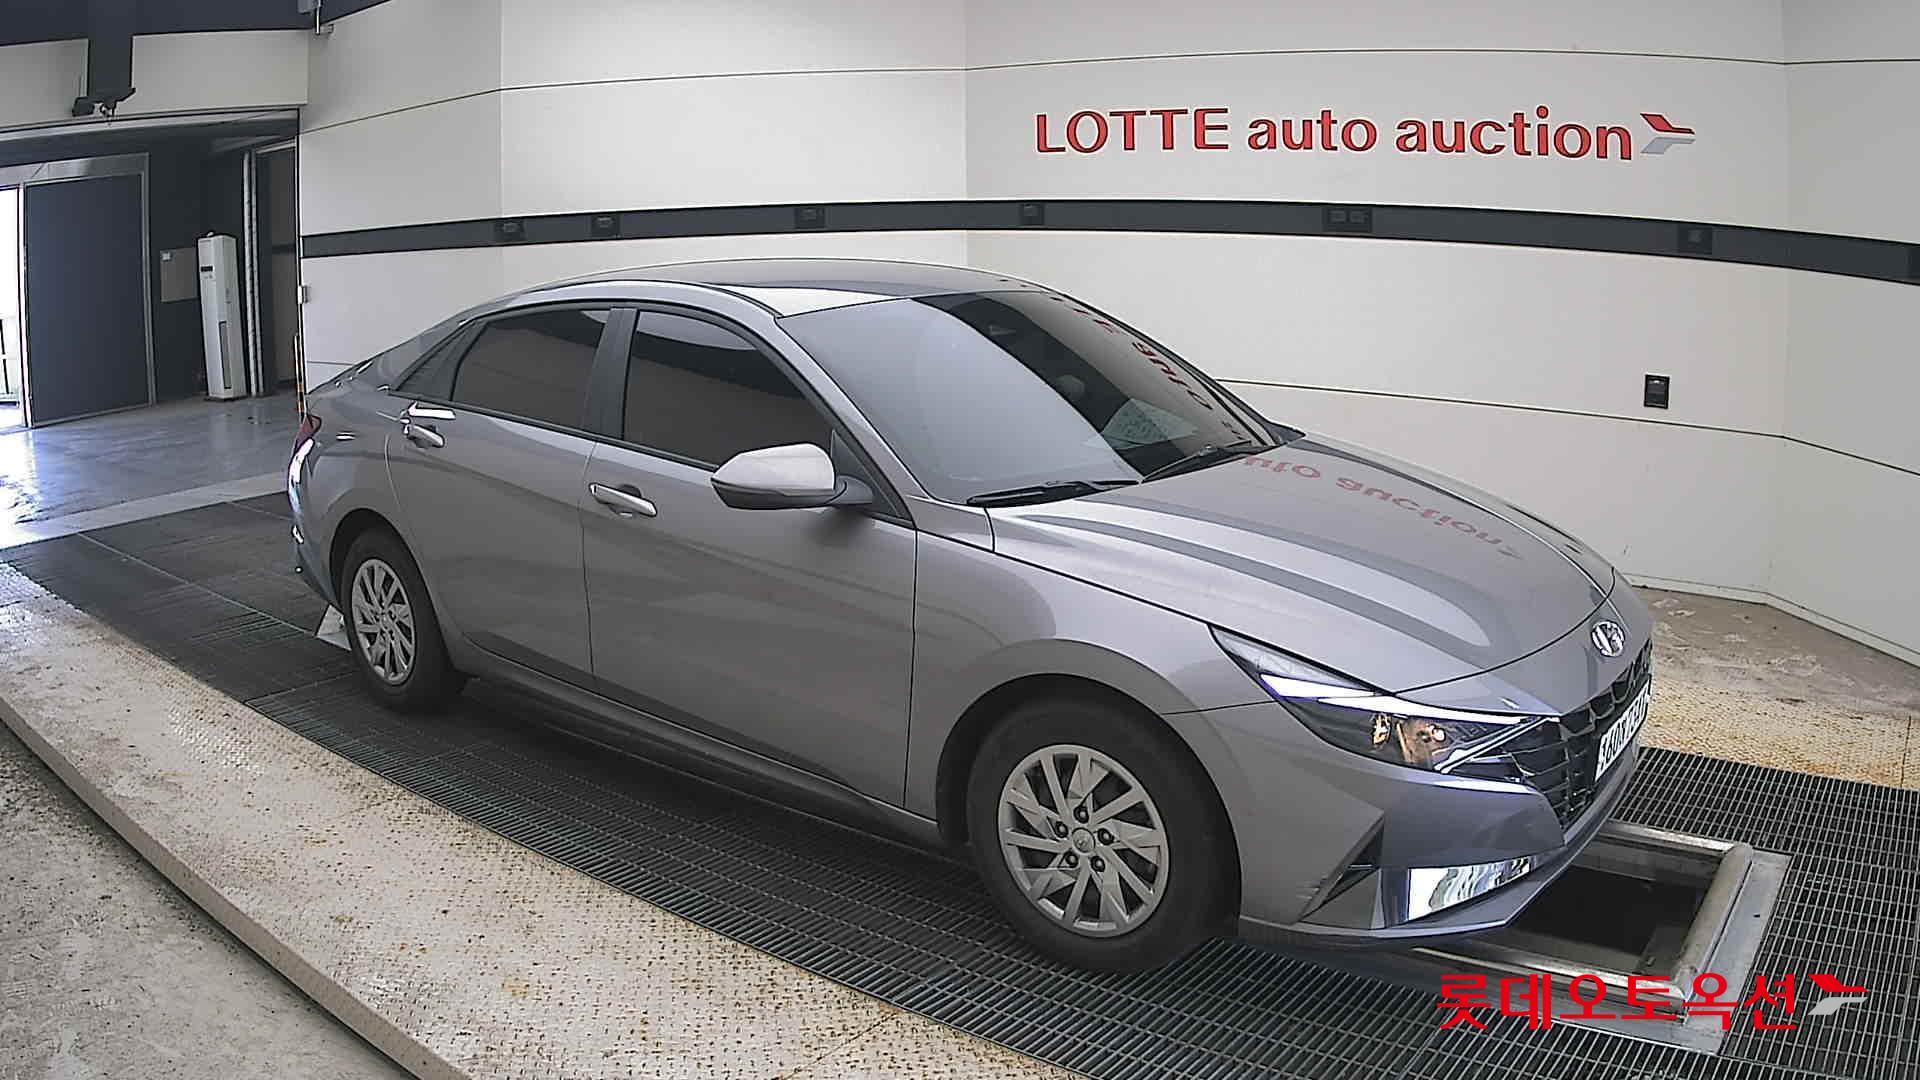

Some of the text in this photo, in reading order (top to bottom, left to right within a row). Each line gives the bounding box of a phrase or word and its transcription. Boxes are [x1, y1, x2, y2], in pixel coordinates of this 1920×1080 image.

[1035, 105, 1633, 160] LOTTE auto auction
